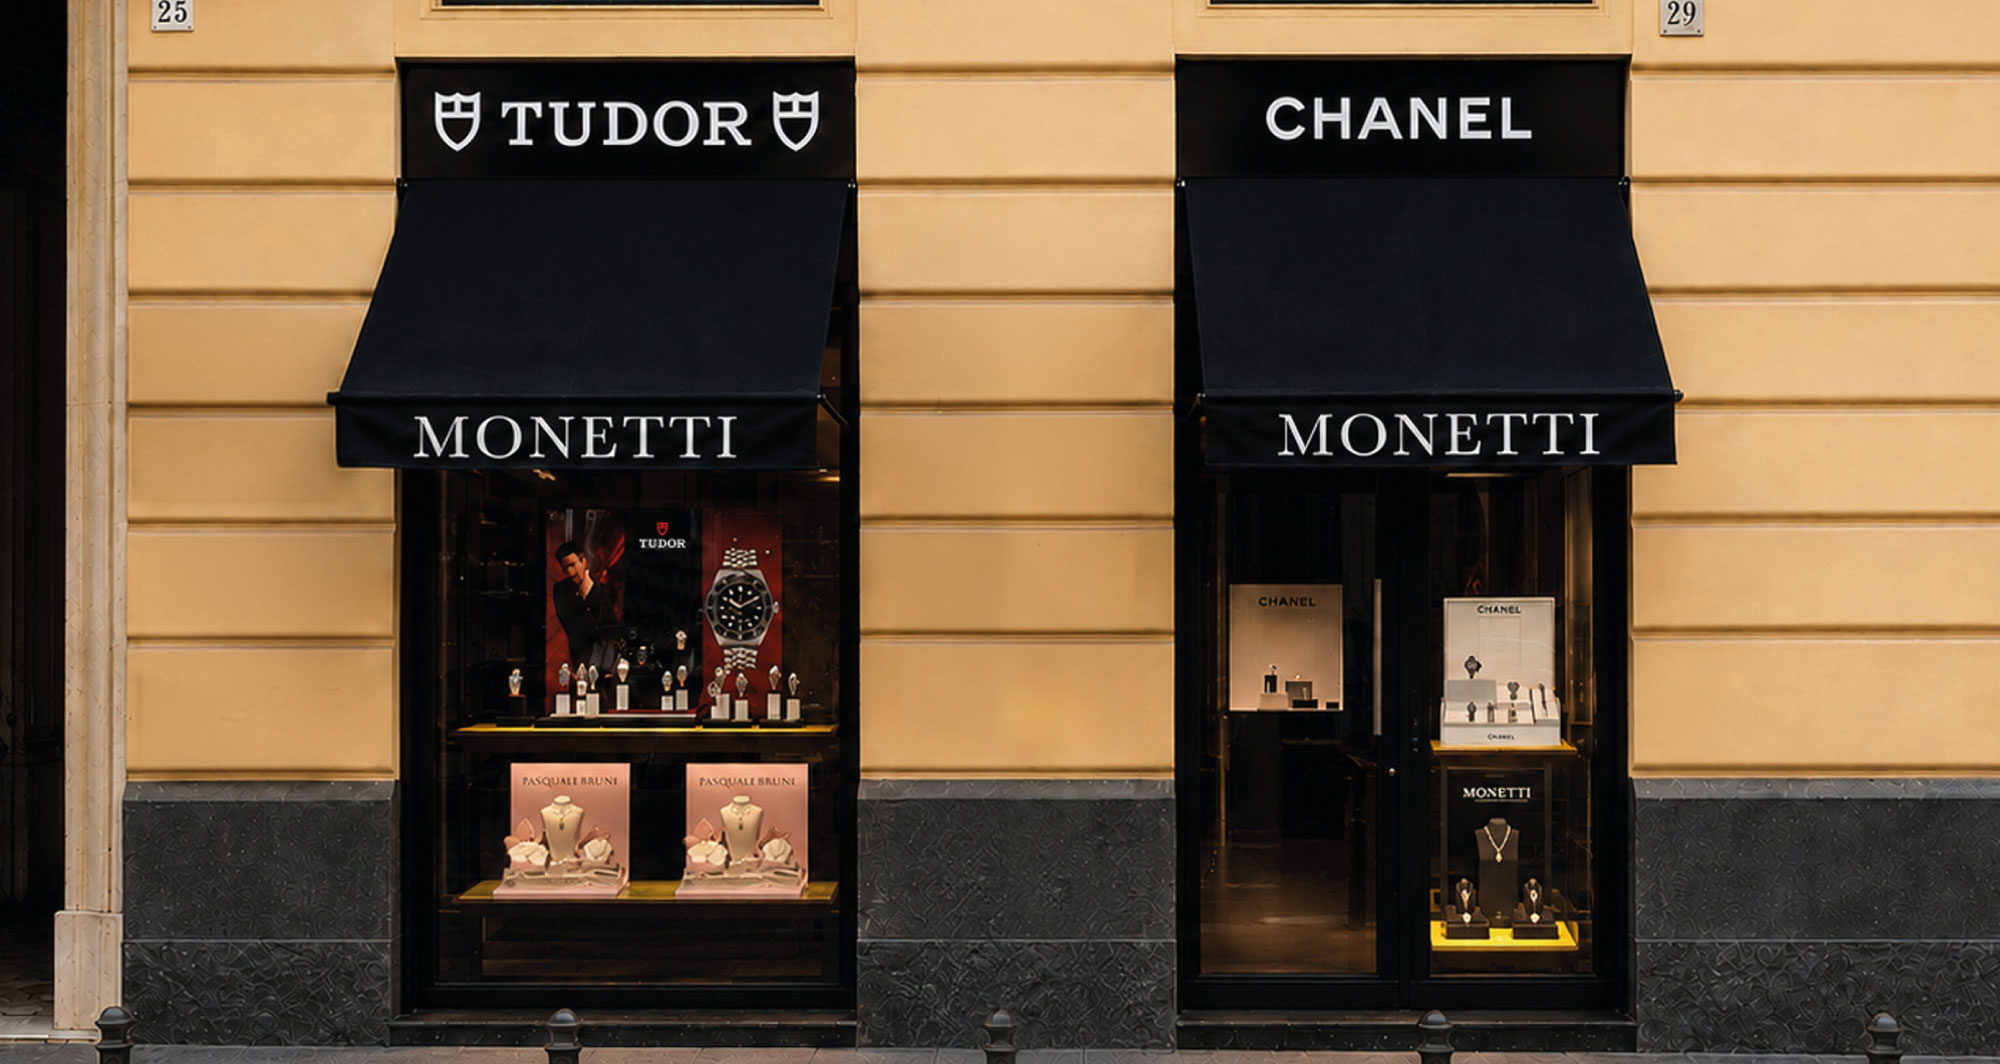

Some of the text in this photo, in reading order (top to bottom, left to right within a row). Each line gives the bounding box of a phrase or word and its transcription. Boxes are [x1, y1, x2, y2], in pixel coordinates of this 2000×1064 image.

[158, 0, 187, 23] 25
[1667, 1, 1696, 26] 29
[501, 100, 752, 147] TUDOR
[1265, 96, 1533, 141] CHANEL
[413, 415, 738, 459] MONETTI
[1277, 413, 1601, 457] MONETTI
[639, 538, 686, 549] TUDOR
[1258, 596, 1316, 607] CHANEL
[1476, 604, 1522, 614] CHANEL
[522, 776, 617, 787] PASQUALE BRUNI
[699, 776, 755, 788] PASQUALE
[1462, 787, 1531, 798] MONETTI
